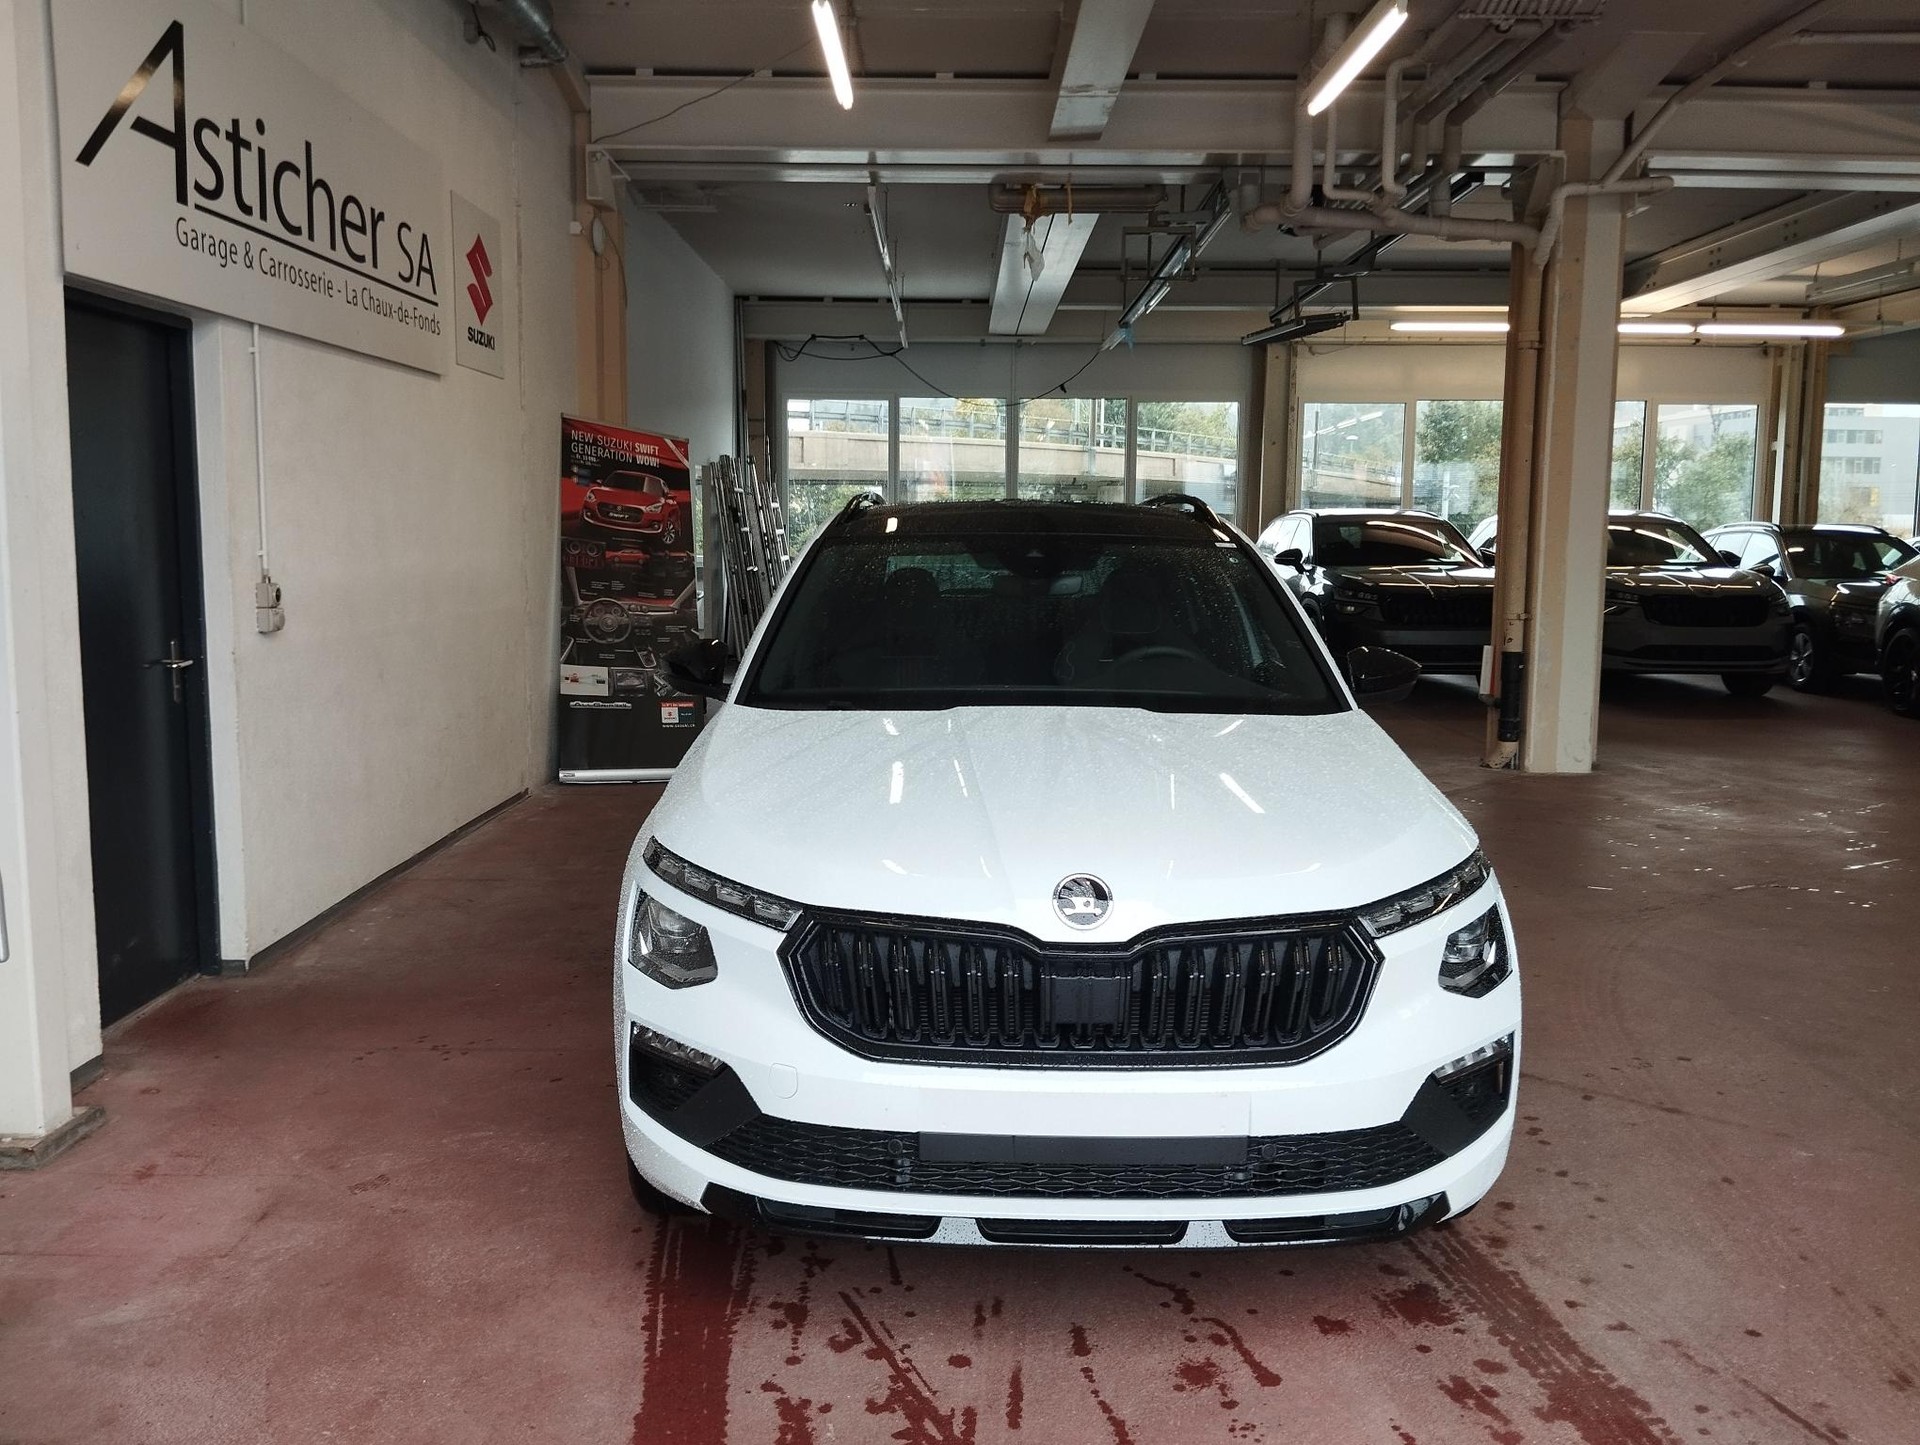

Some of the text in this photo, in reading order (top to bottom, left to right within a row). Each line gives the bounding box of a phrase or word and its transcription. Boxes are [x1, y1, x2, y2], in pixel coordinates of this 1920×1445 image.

[75, 19, 438, 295] Asticher SA
[176, 216, 238, 268] Garage
[243, 241, 254, 270] &
[259, 247, 334, 299] Carrosserie
[345, 280, 358, 307] La
[361, 286, 441, 336] Chaux-de-Fonds
[467, 326, 496, 351] SUZUKI
[571, 429, 660, 456] NEW SUZUKI SWIFT
[571, 441, 633, 464] GENERATION
[636, 454, 660, 468] WOW!
